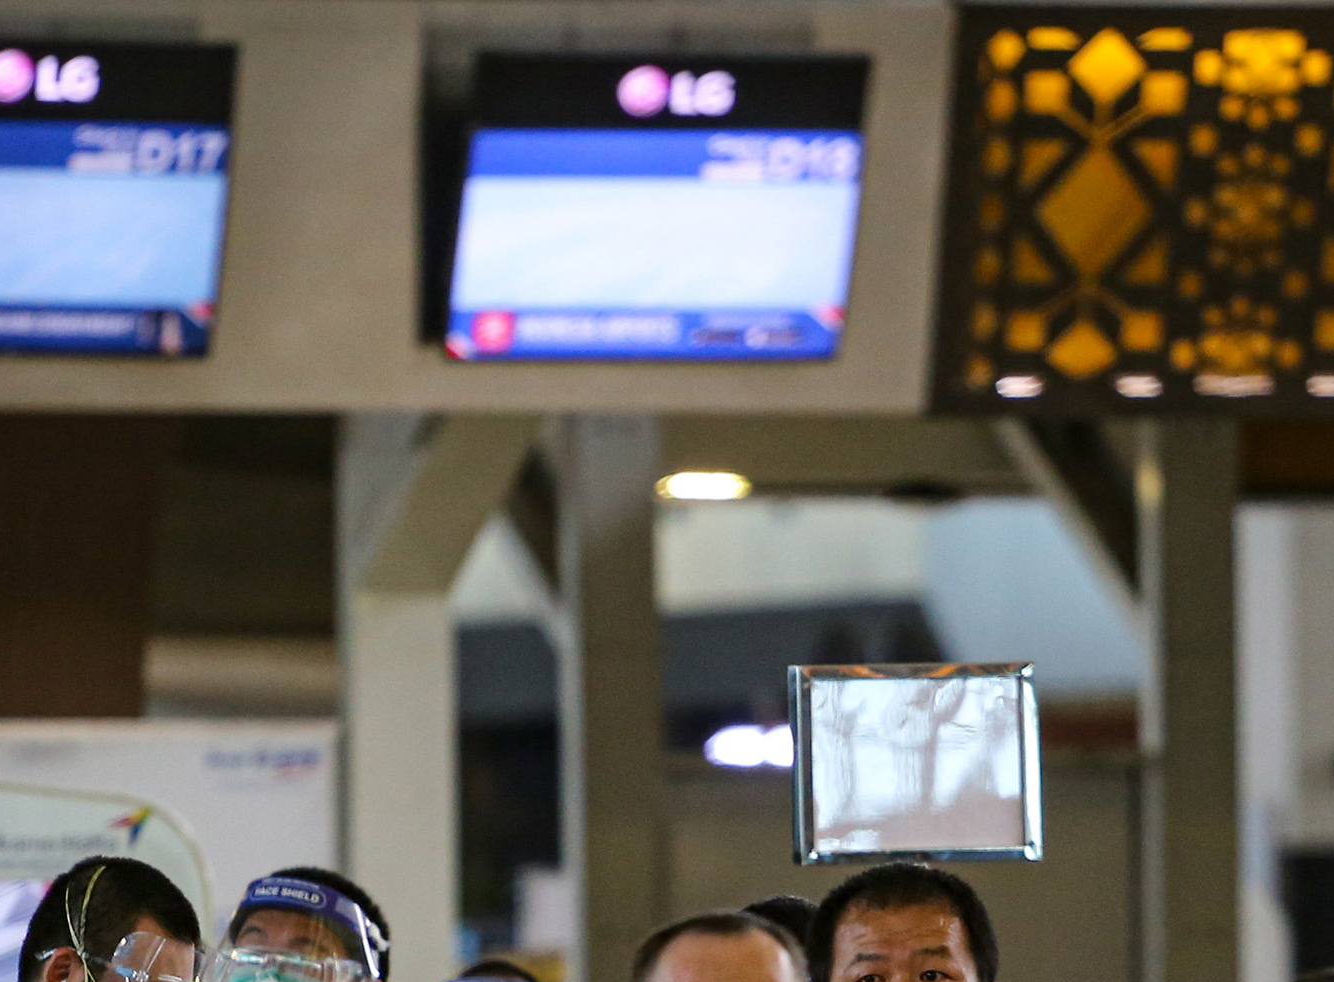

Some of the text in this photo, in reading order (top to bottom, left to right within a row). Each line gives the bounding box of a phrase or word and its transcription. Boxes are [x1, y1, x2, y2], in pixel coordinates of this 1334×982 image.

[35, 54, 100, 103] LG
[669, 70, 736, 117] LG
[136, 128, 229, 174] D17
[254, 885, 320, 904] FACE SHIELD
